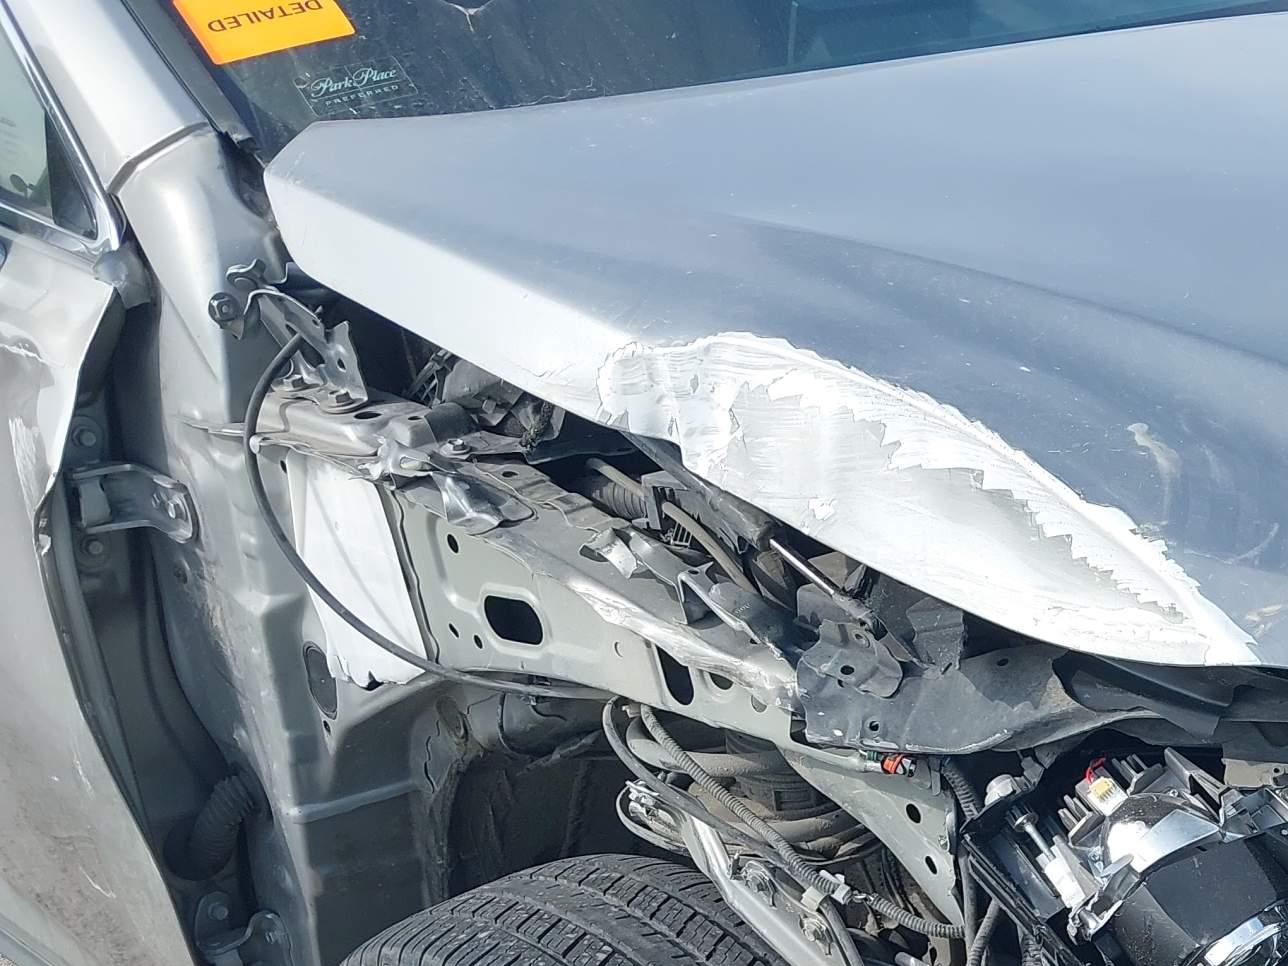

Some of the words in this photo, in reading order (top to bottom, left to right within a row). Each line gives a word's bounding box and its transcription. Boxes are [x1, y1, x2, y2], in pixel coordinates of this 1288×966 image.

[207, 0, 324, 33] DETAILED
[311, 77, 353, 97] Park
[353, 67, 397, 87] Place
[325, 84, 399, 106] PREFERRED
